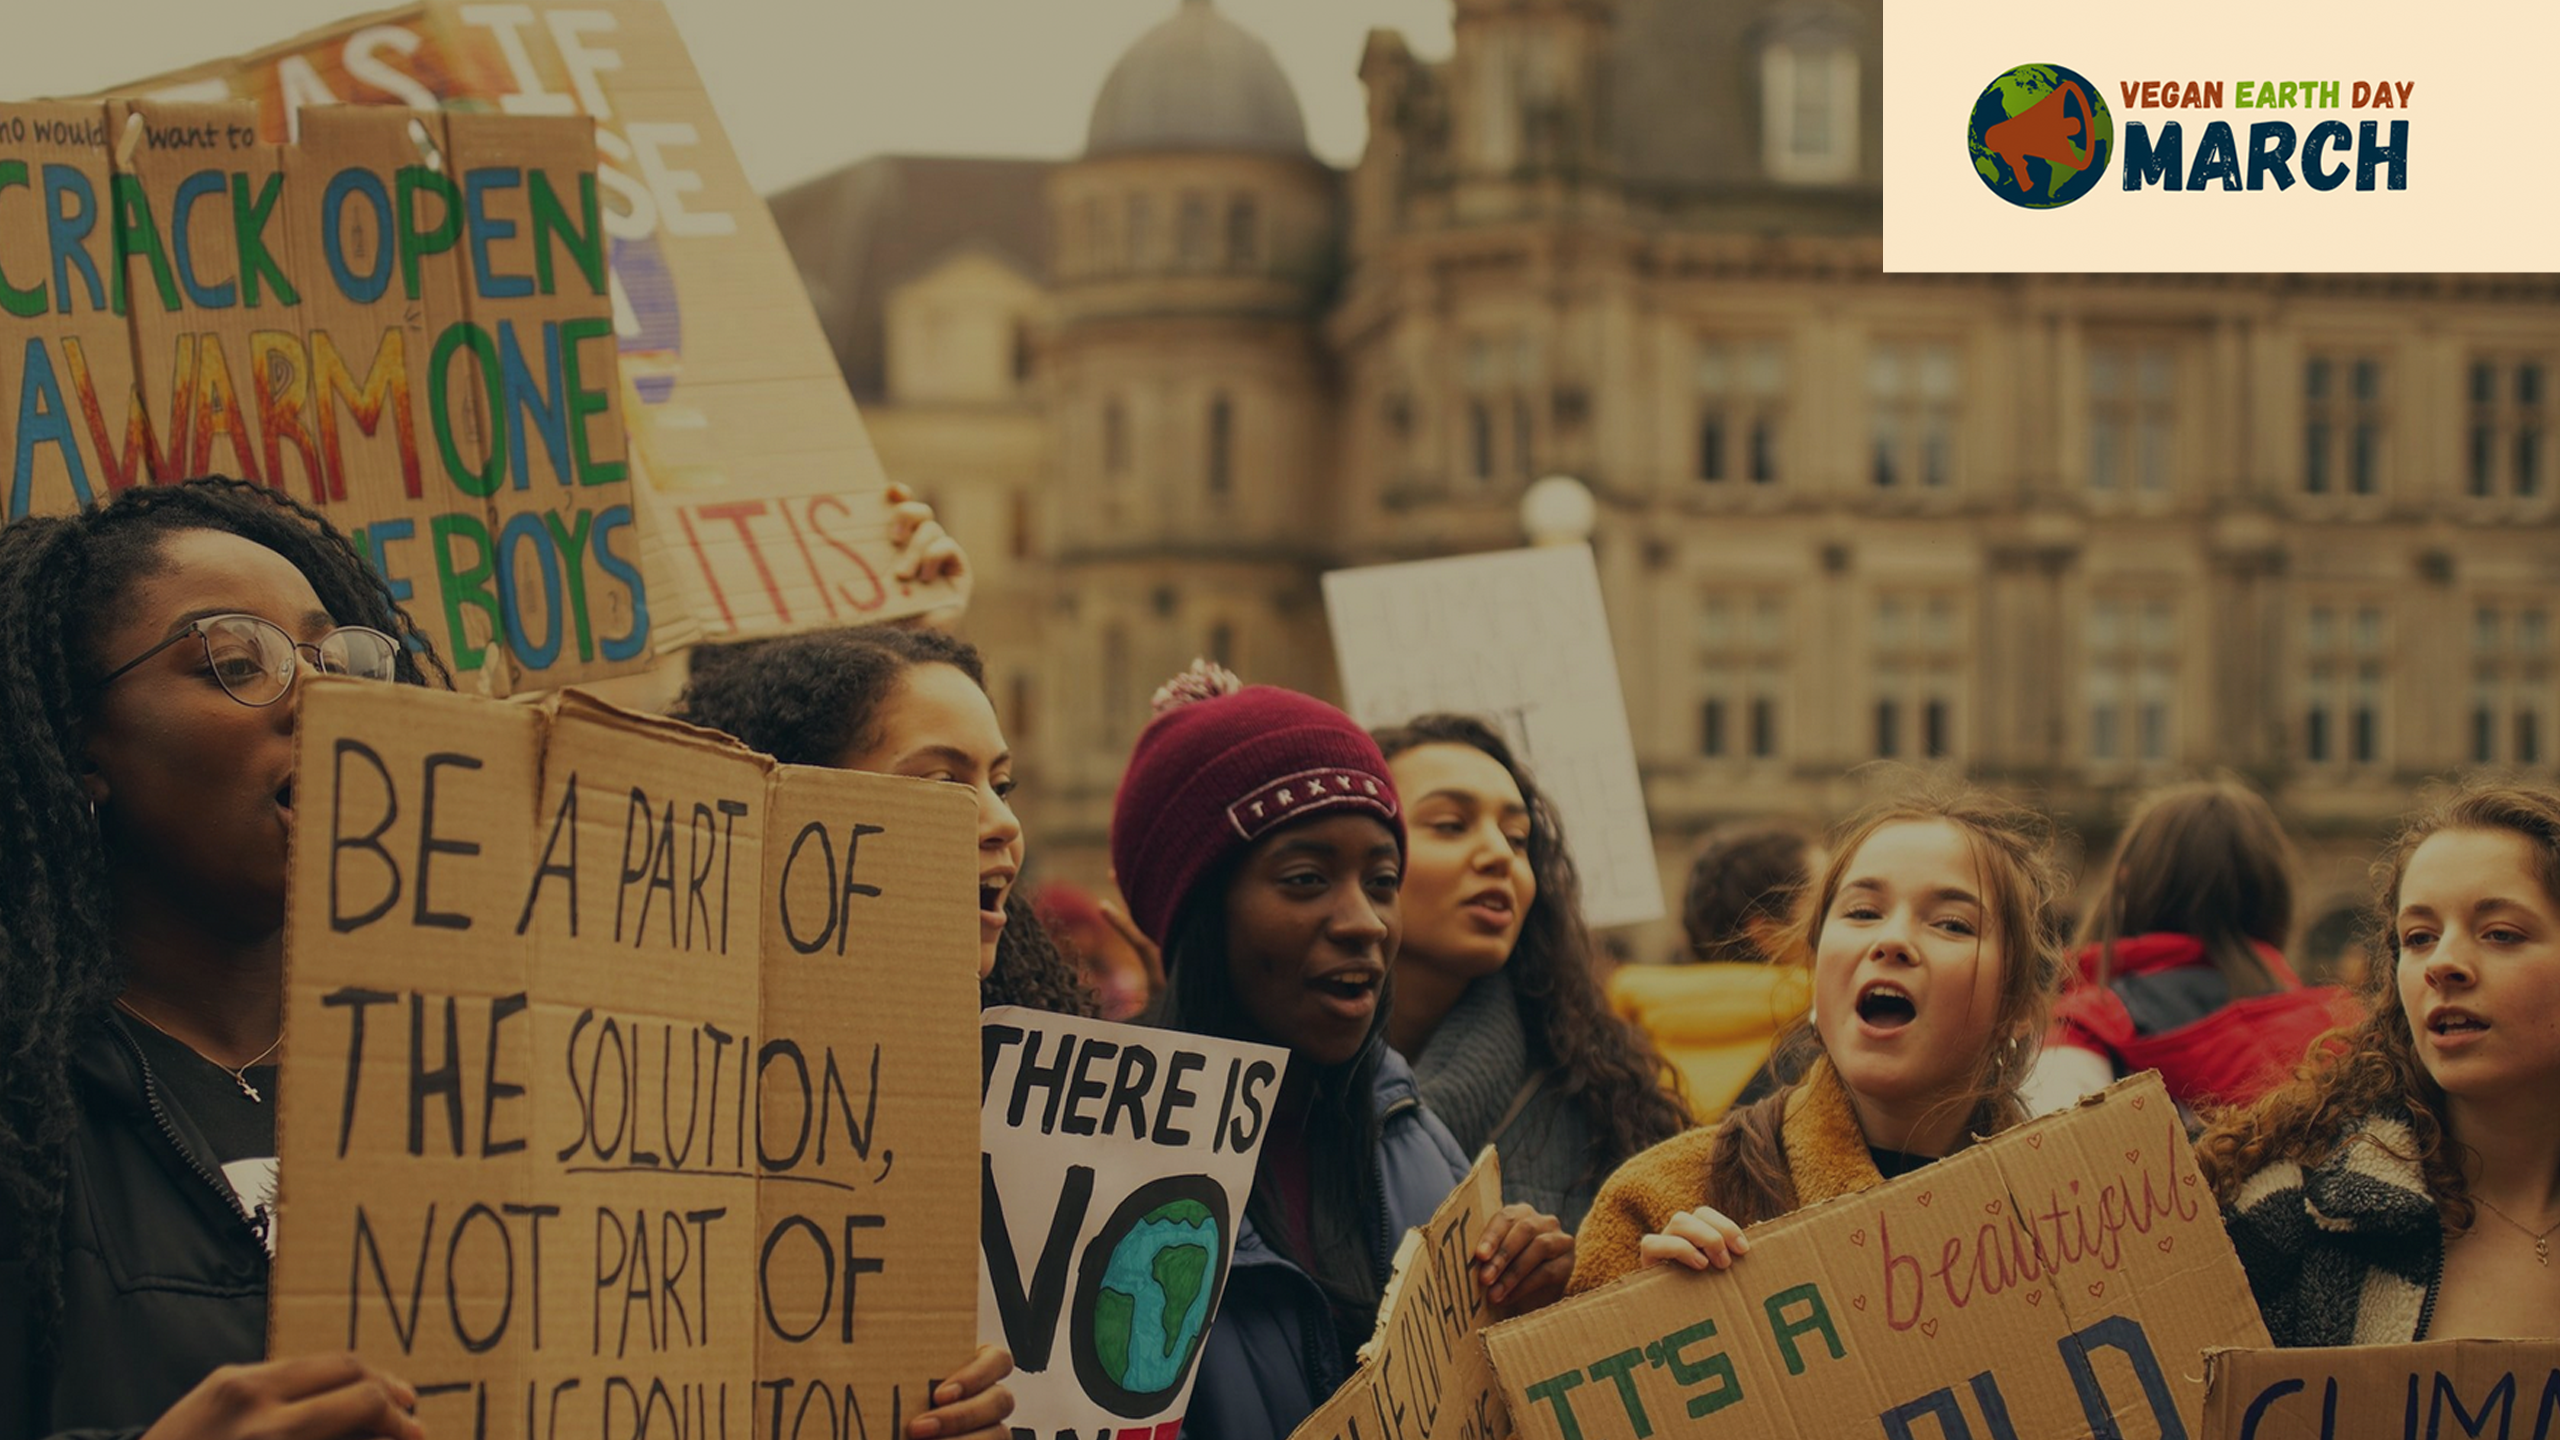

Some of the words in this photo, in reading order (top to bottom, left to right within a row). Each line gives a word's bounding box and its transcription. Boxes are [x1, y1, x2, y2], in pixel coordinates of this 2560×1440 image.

[146, 123, 219, 149] want
[226, 123, 254, 149] to
[459, 3, 623, 120] IF
[0, 160, 302, 318] CRACK
[322, 165, 606, 305] OPEN
[8, 337, 97, 522] A
[61, 325, 424, 505] WARM
[428, 317, 628, 498] ONE
[430, 505, 650, 673] BOYS
[677, 502, 793, 637] IT
[329, 739, 483, 933] BE
[516, 771, 578, 937] A
[614, 786, 748, 955] PART
[780, 822, 885, 956] OF
[321, 986, 527, 1160] THE
[557, 1008, 895, 1183] SOLUTION,
[981, 1024, 1206, 1148] THERE
[1213, 1057, 1277, 1155] IS
[347, 1202, 560, 1356] NOT
[592, 1206, 727, 1359] PART
[759, 1214, 886, 1344] OF
[1879, 1118, 2199, 1332] beautiful
[1401, 1206, 1484, 1439] CLIMATE
[1763, 1282, 1848, 1376] A
